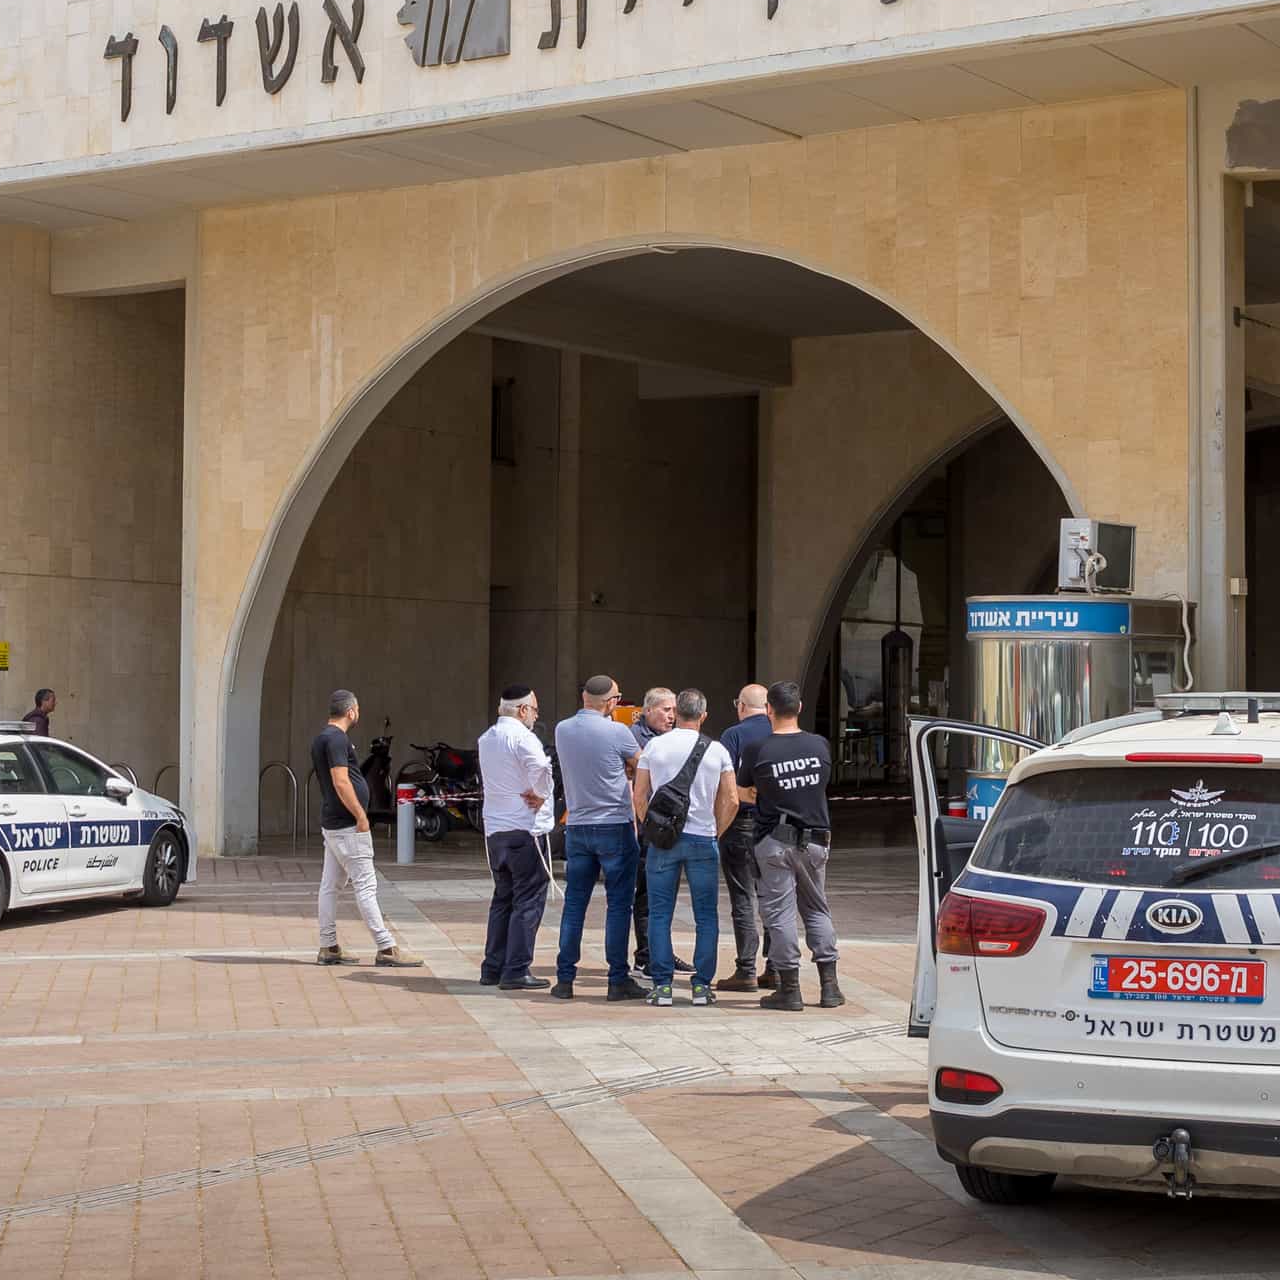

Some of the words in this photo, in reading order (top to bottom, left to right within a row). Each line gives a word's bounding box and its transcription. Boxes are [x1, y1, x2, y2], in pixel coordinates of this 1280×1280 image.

[970, 611, 1010, 627] אשדוד
[1015, 610, 1079, 627] עיריית
[771, 757, 821, 778] ביטחון
[778, 773, 820, 790] עירוני
[11, 823, 61, 848] ישראל
[80, 824, 130, 845] משטרת
[1198, 822, 1249, 848] 100
[1153, 847, 1181, 858] מוקד
[22, 858, 59, 872] POLICE
[1158, 908, 1191, 924] KIA
[1084, 1014, 1164, 1038] ישראל
[1177, 1023, 1277, 1043] משטרת
